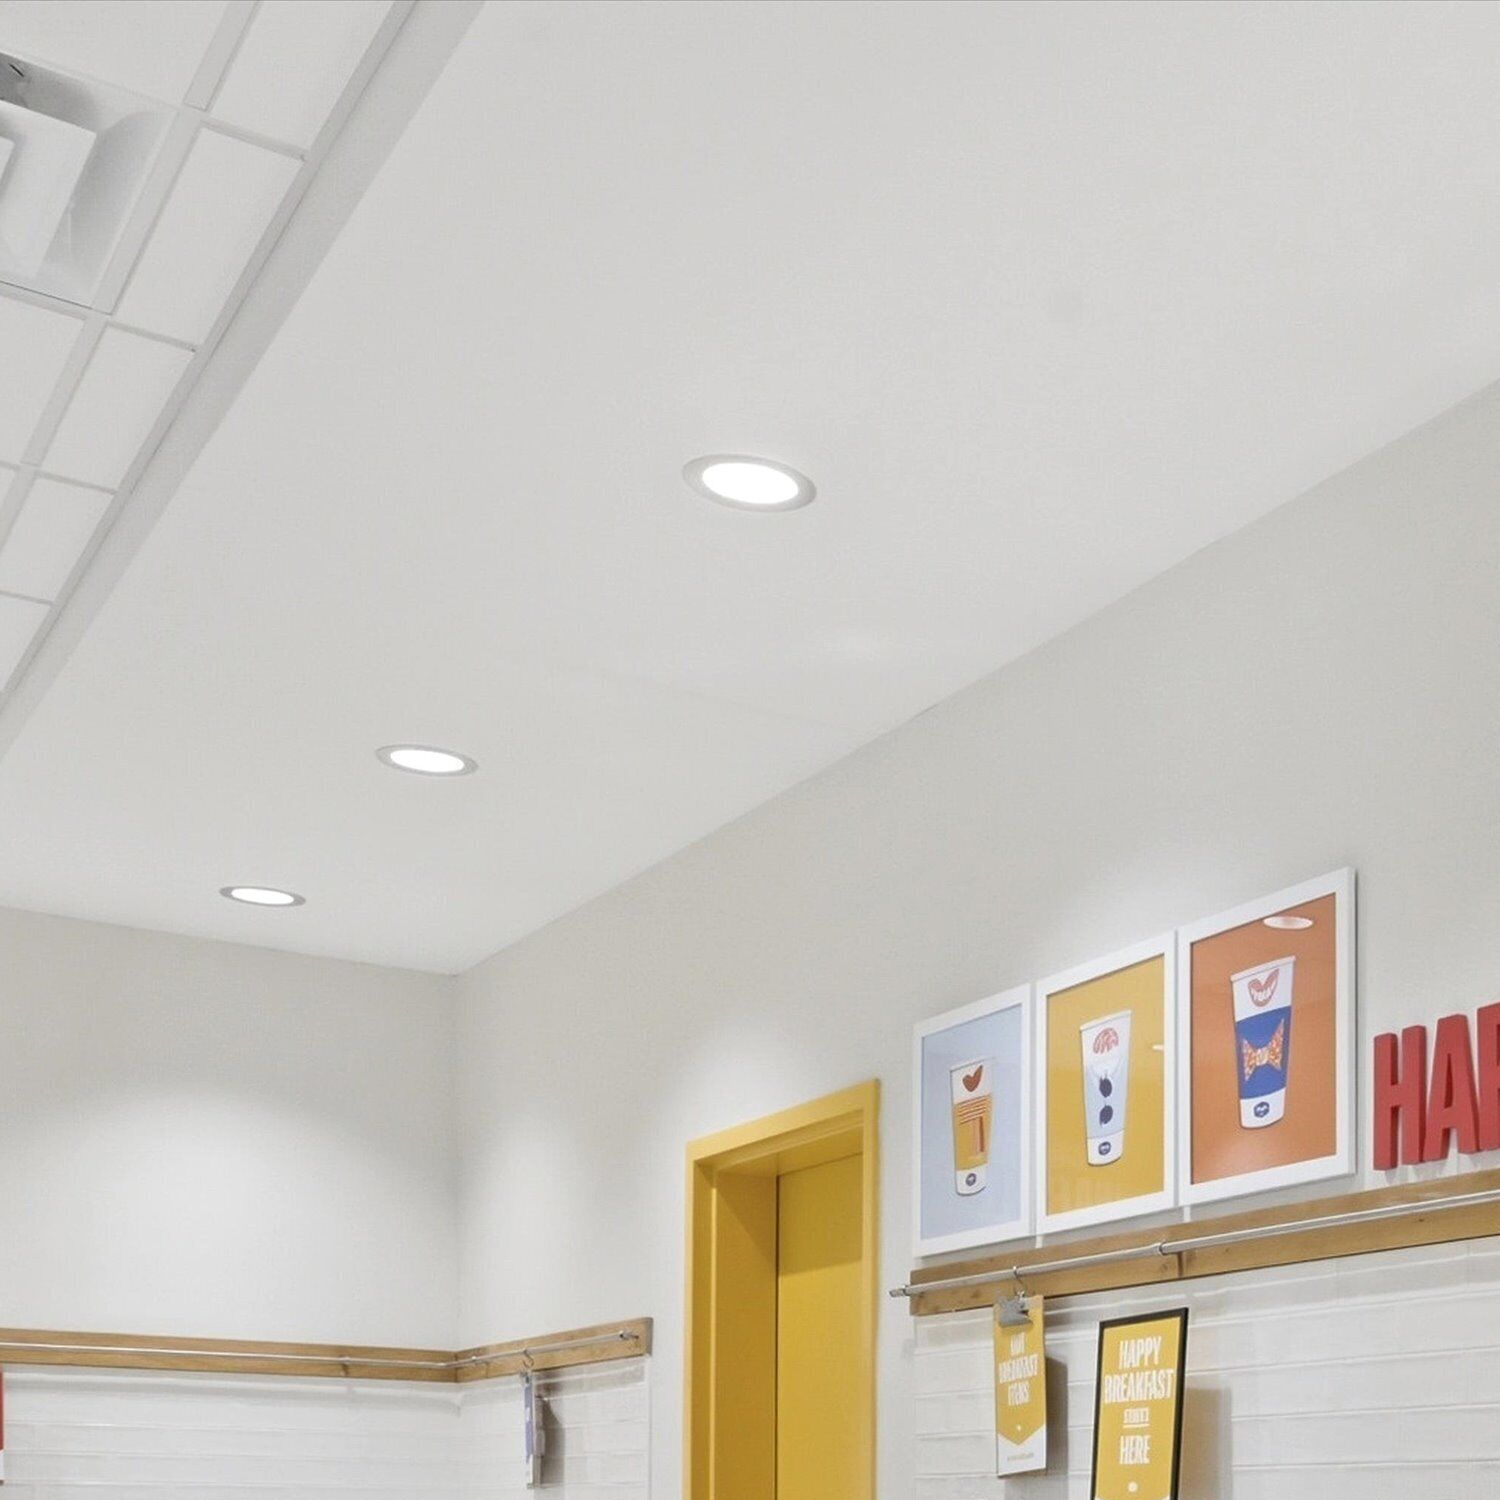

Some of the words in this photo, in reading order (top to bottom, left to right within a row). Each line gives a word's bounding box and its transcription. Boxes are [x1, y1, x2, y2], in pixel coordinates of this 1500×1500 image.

[1119, 1336, 1162, 1370] HAPPY
[1104, 1368, 1174, 1404] BREAKFAST
[1120, 1435, 1150, 1464] HERE
